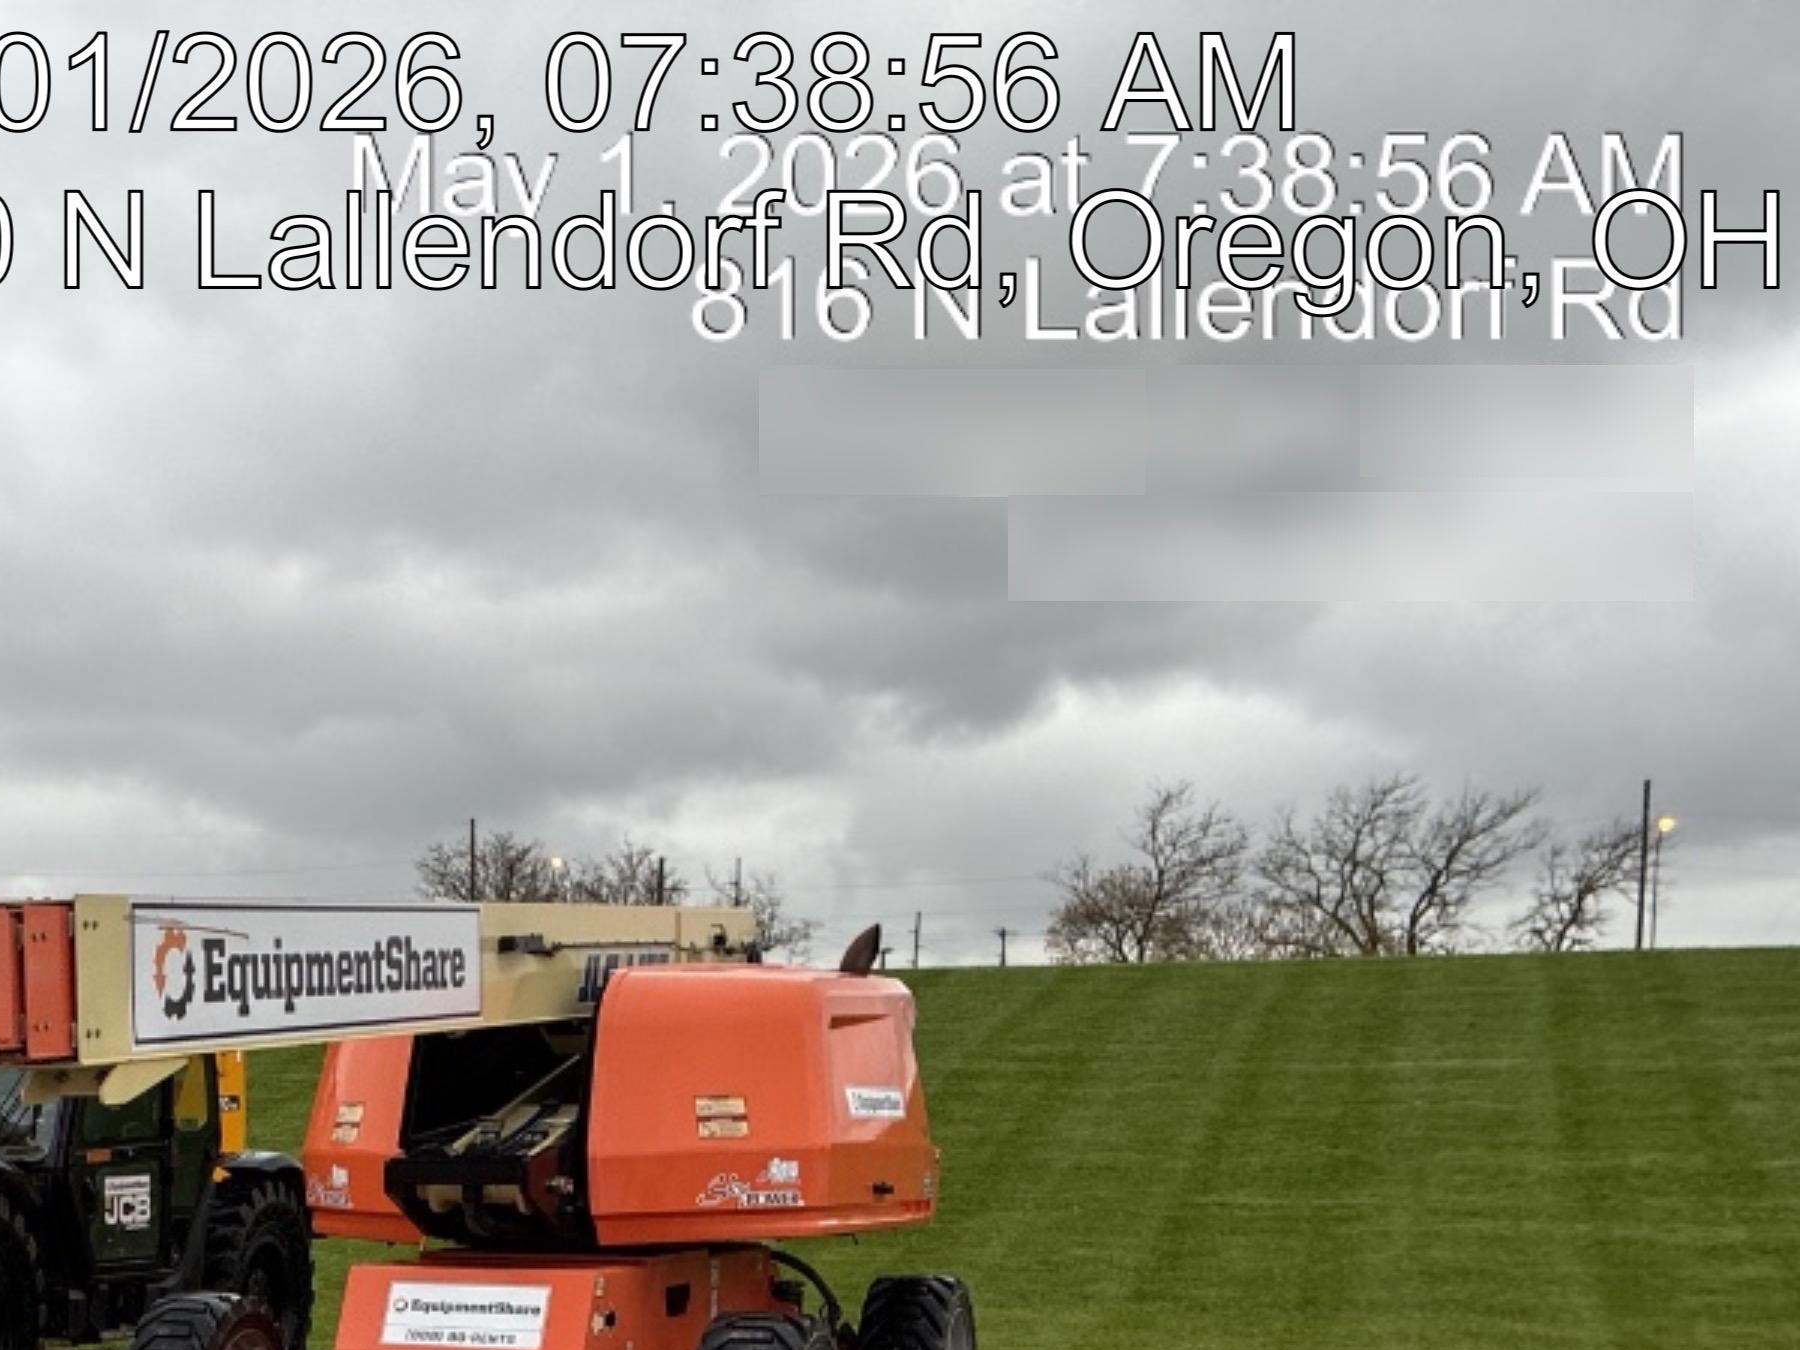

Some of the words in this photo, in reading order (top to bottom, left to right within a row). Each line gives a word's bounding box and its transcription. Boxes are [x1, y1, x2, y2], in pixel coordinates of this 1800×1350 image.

[201, 935, 466, 1017] EquipmentShare
[104, 1195, 150, 1224] JCB
[410, 1298, 542, 1316] EquipmentShare
